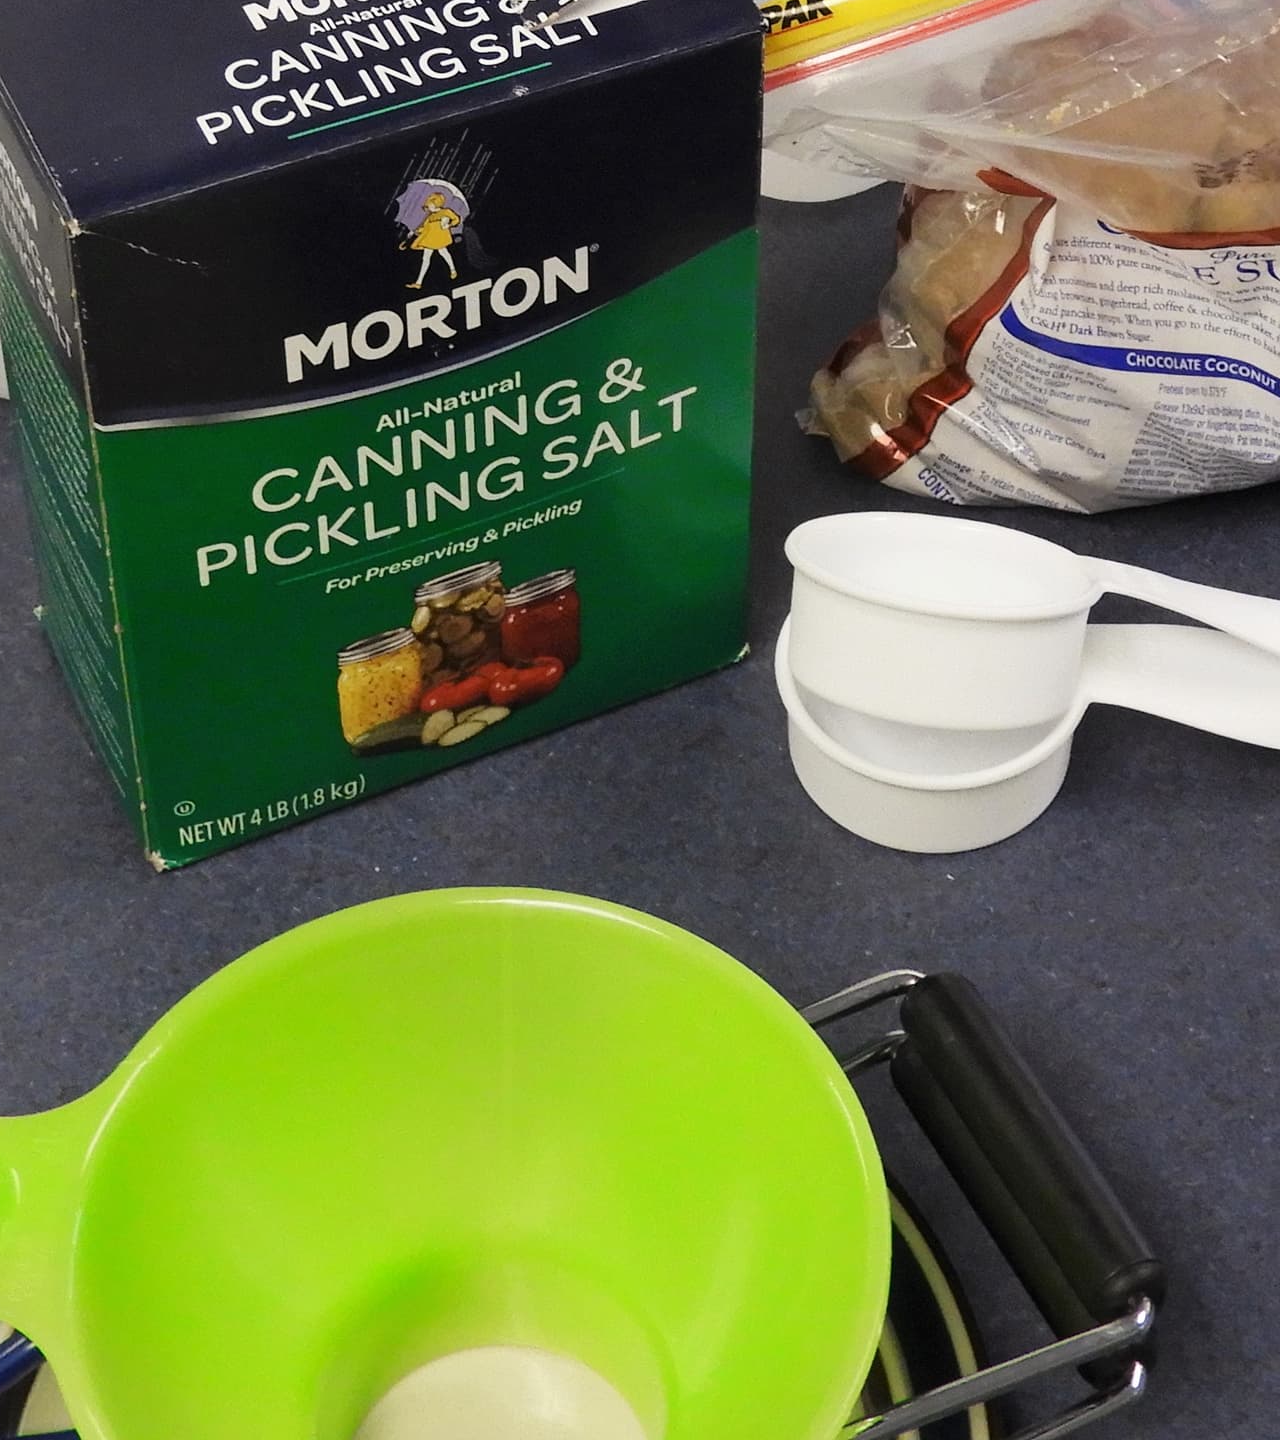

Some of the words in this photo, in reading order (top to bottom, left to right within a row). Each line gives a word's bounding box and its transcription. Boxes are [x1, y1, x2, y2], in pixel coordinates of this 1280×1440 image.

[196, 46, 467, 145] PICKLING
[1071, 236, 1111, 249] different
[1089, 254, 1114, 266] 100%
[1116, 259, 1138, 268] pure
[1210, 250, 1274, 264] Pure
[1117, 280, 1140, 294] deep
[1143, 283, 1164, 294] rich
[1167, 288, 1210, 303] molasses
[283, 245, 589, 384] MORTON
[1039, 305, 1058, 315] and
[1124, 314, 1152, 326] When
[1154, 319, 1172, 328] you
[1174, 320, 1187, 330] go
[1190, 320, 1200, 329] to
[1204, 322, 1221, 333] the
[1223, 327, 1251, 341] effort
[1253, 336, 1262, 346] to
[1069, 323, 1094, 336] Dark
[1097, 326, 1125, 339] Brown
[1153, 299, 1184, 313] coffee
[1201, 307, 1249, 326] chocolate
[1126, 352, 1201, 372] CHOCOLATE
[1204, 358, 1276, 390] COCONUT
[376, 371, 521, 433] All-Natural
[250, 379, 580, 513] CANNING
[597, 357, 647, 402] &
[1043, 429, 1064, 443] Pure
[195, 455, 525, 588] PICKLING
[542, 386, 698, 481] SALT
[325, 574, 362, 594] For
[365, 535, 480, 581] Preserving
[482, 528, 499, 543] &
[502, 499, 582, 537] Pickling
[179, 820, 214, 847] NET
[216, 812, 246, 836] WT
[250, 808, 263, 826] 4
[267, 800, 290, 822] LB
[292, 788, 325, 816] (1.8
[330, 773, 366, 800] kg)
